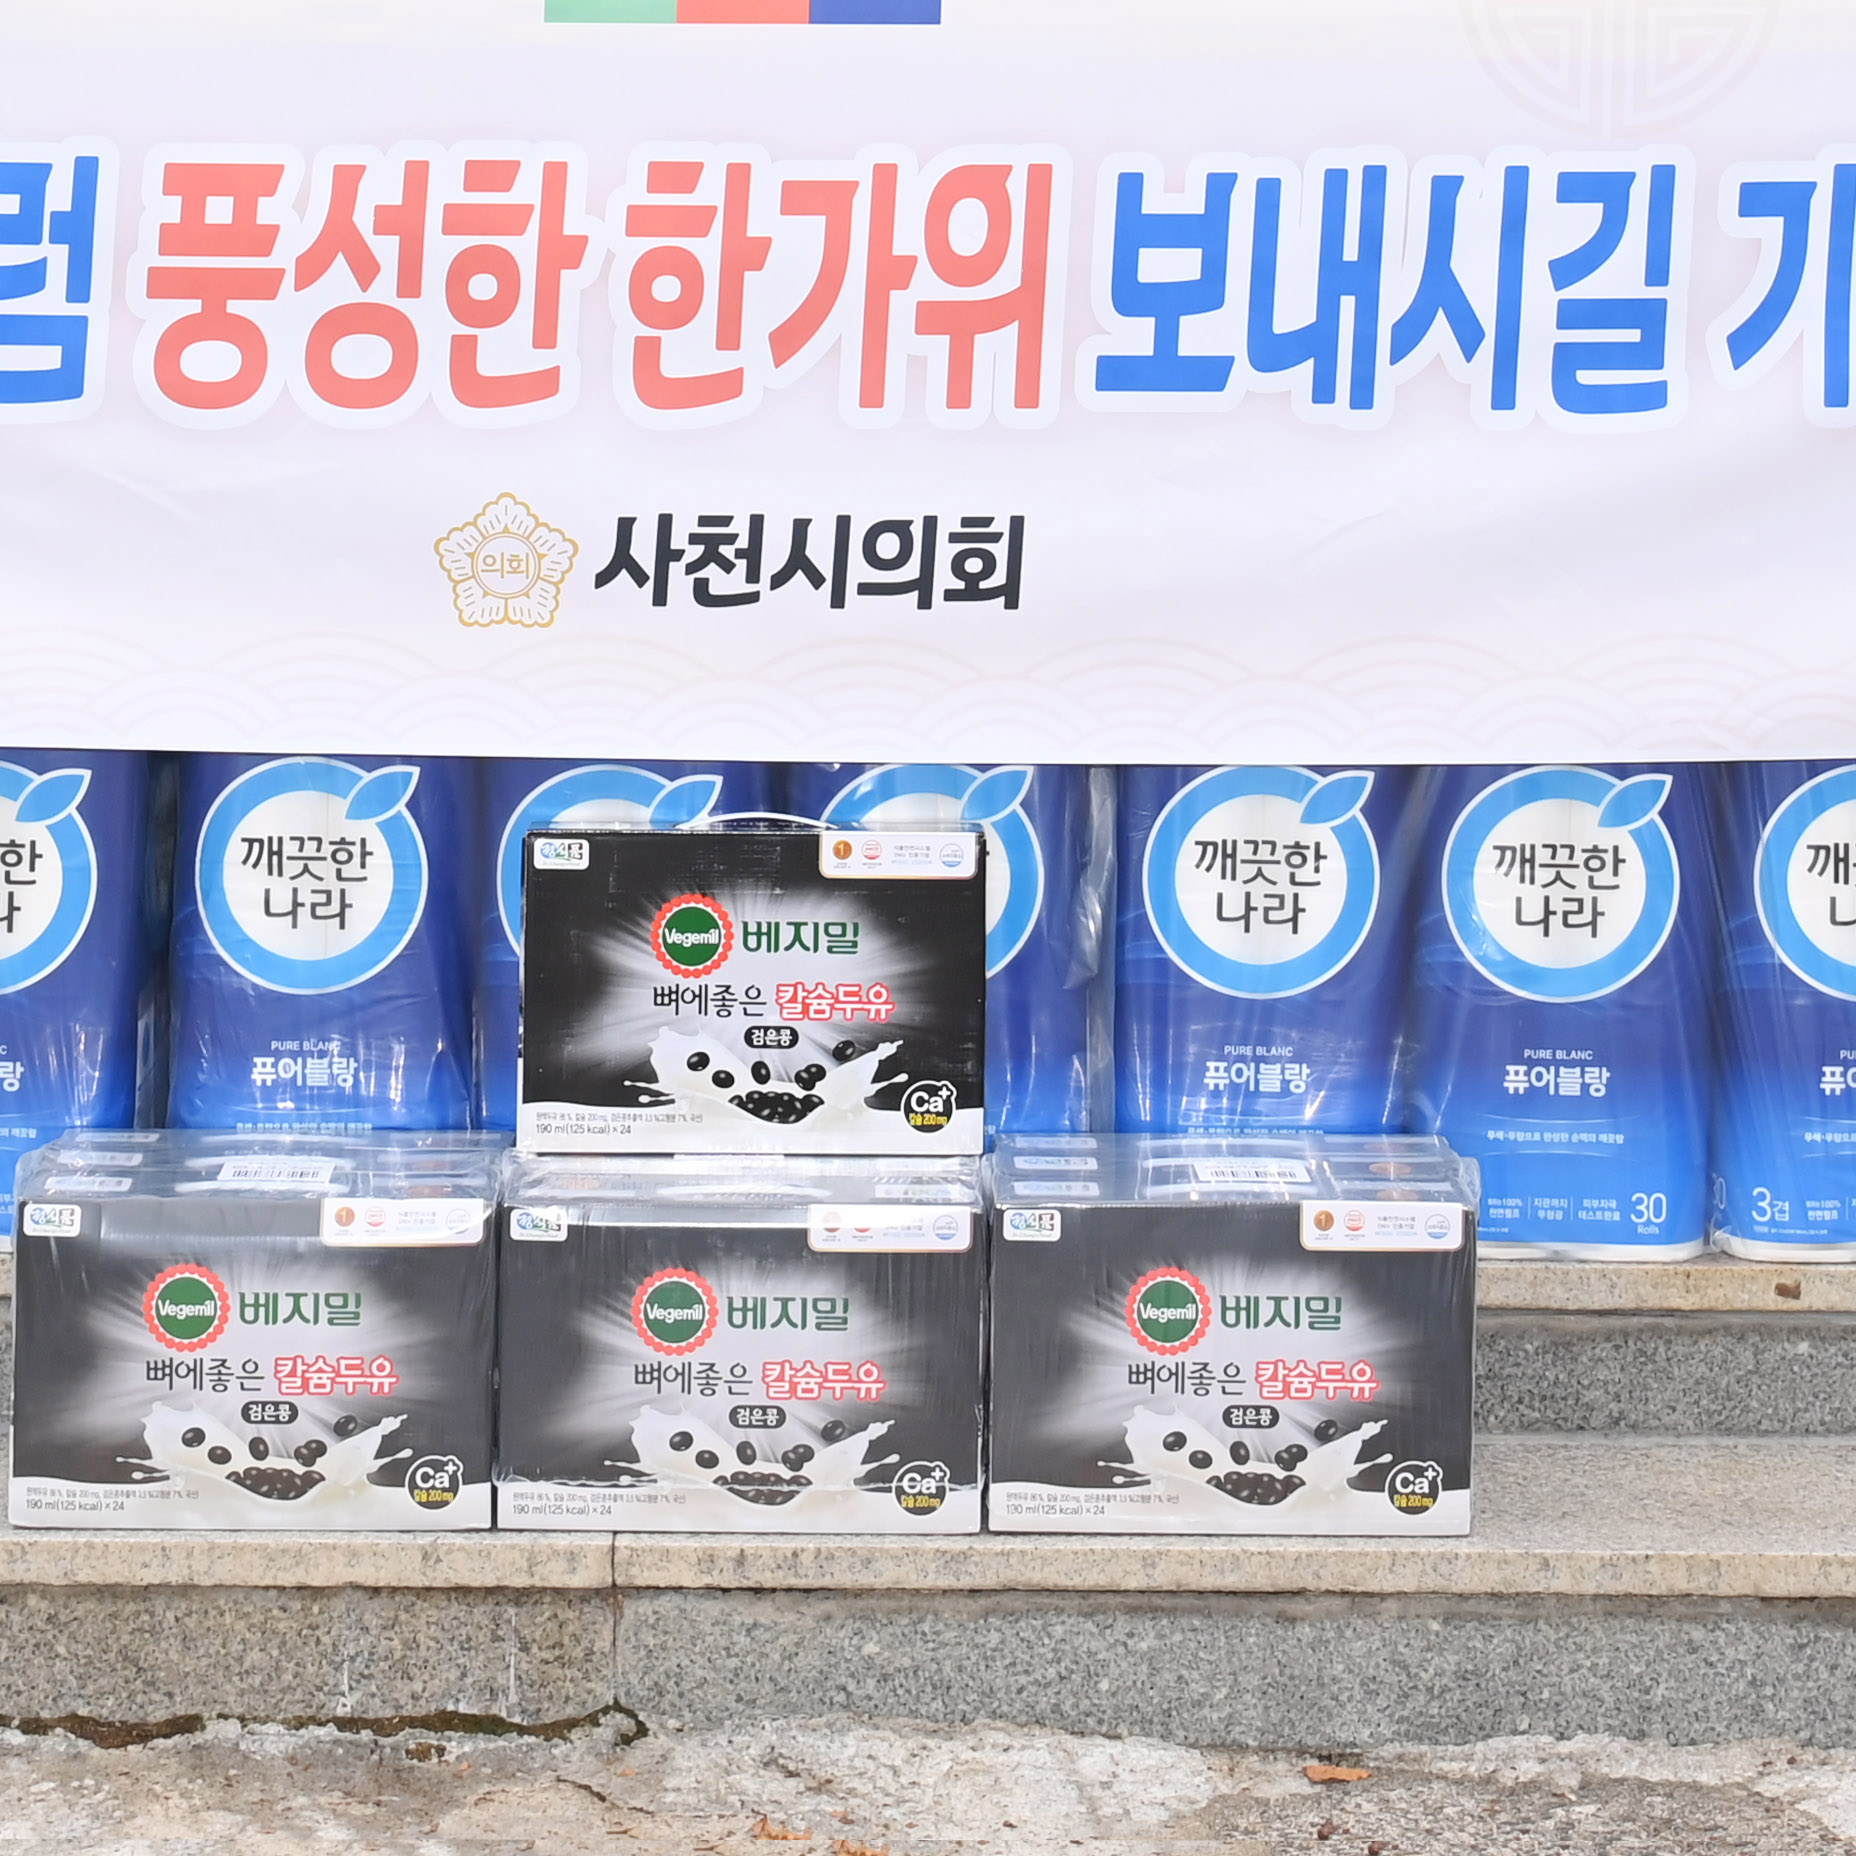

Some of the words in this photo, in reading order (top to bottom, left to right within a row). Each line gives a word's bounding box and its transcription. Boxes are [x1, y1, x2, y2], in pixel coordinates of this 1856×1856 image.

[146, 158, 589, 410] 풍성한
[623, 160, 1053, 410] 한가위
[1094, 162, 1676, 415] 보내시길
[480, 549, 533, 581] 의회
[593, 513, 1026, 611] 사천시의회
[240, 835, 375, 885] 깨끗한
[1193, 839, 1328, 888] 깨끗한
[1492, 842, 1626, 891] 깨끗한
[263, 886, 353, 931] 나라
[1216, 891, 1307, 935] 나라
[1514, 895, 1605, 939] 나라
[663, 928, 719, 948] Vegemil
[742, 921, 860, 955] 베지밀
[652, 984, 767, 1018] 뼈에좋은
[775, 982, 895, 1022] 칼슘두유
[271, 1039, 301, 1051] PURE
[303, 1040, 342, 1052] BLANC
[750, 1028, 793, 1047] 검은콩
[1224, 1044, 1254, 1057] PURE
[1256, 1045, 1294, 1058] BLANC
[1523, 1048, 1554, 1060] PURE
[1556, 1048, 1593, 1061] BLANC
[250, 1054, 359, 1087] 퓨어블랑
[1203, 1060, 1311, 1094] 퓨어블랑
[1502, 1064, 1611, 1097] 퓨어블랑
[619, 1125, 631, 1134] 24
[1630, 1192, 1667, 1223] 30
[1751, 1186, 1789, 1222] 3겹
[157, 1298, 216, 1320] Vegemil
[238, 1291, 362, 1327] 베지밀
[646, 1301, 703, 1323] Vegemil
[726, 1295, 850, 1331] 베지밀
[1140, 1301, 1196, 1323] Vegemil
[1219, 1295, 1342, 1331] 베지밀
[146, 1356, 265, 1392] 뼈에좋은
[275, 1354, 400, 1395] 칼슘두유
[634, 1361, 753, 1397] 뼈에좋은
[762, 1360, 887, 1401] 칼슘두유
[1128, 1360, 1247, 1397] 뼈에좋은
[1256, 1358, 1380, 1401] 칼슘두유
[247, 1404, 292, 1423] 검은콩
[735, 1408, 779, 1426] 검은콩
[1229, 1408, 1273, 1426] 검은콩
